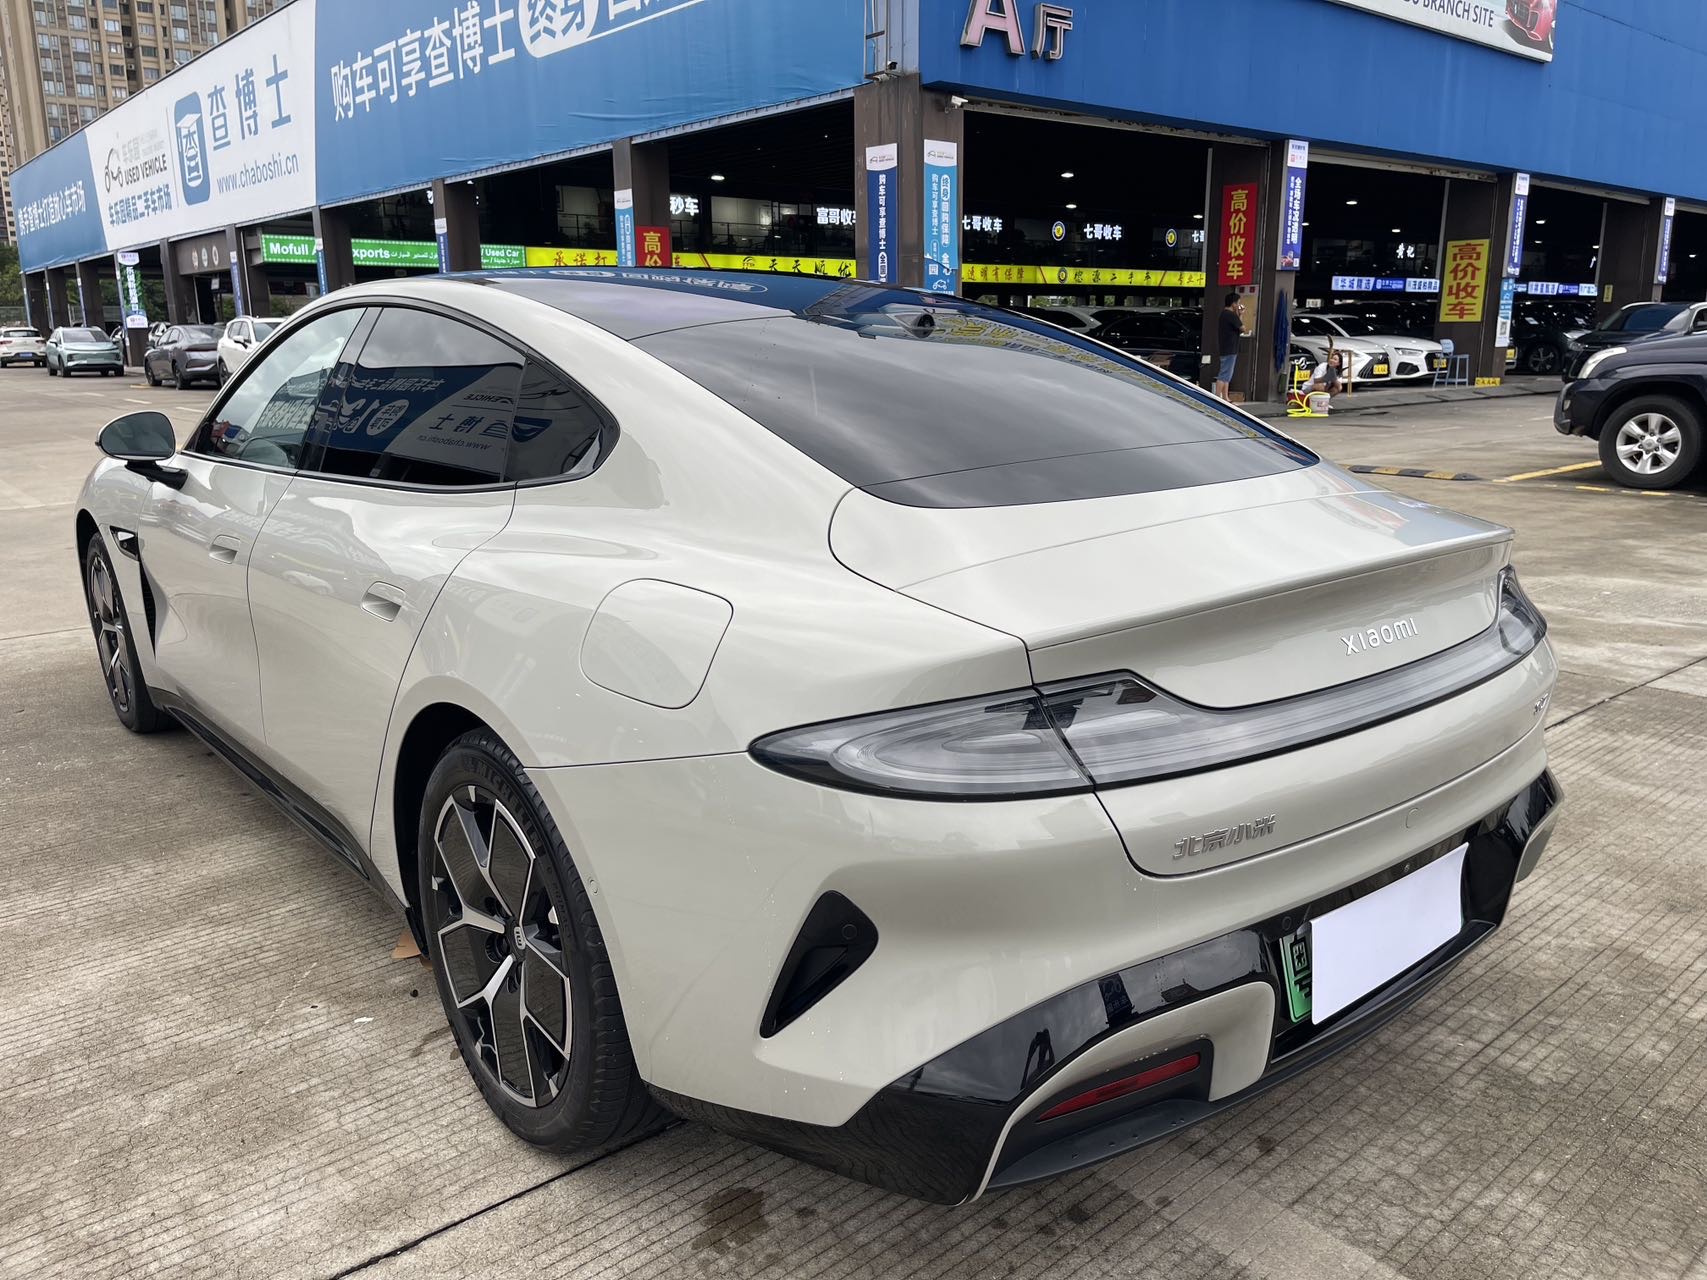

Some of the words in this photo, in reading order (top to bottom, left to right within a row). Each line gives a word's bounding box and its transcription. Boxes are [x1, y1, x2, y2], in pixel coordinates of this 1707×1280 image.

[1472, 5, 1494, 28] SITE
[207, 54, 292, 152] 查博士
[124, 165, 140, 185] USED
[140, 153, 168, 179] VEHICLE
[216, 152, 300, 194] www.chaboshi.cn
[816, 206, 856, 226] 富哥收
[1083, 223, 1122, 242] 七哥收车
[1225, 188, 1249, 280] 高价收车
[269, 241, 308, 256] Mofull
[352, 248, 391, 261] xports
[485, 249, 506, 257] Used
[506, 250, 519, 258] Car
[1444, 242, 1485, 320] 高价收车
[1172, 812, 1276, 861] 北京小米
